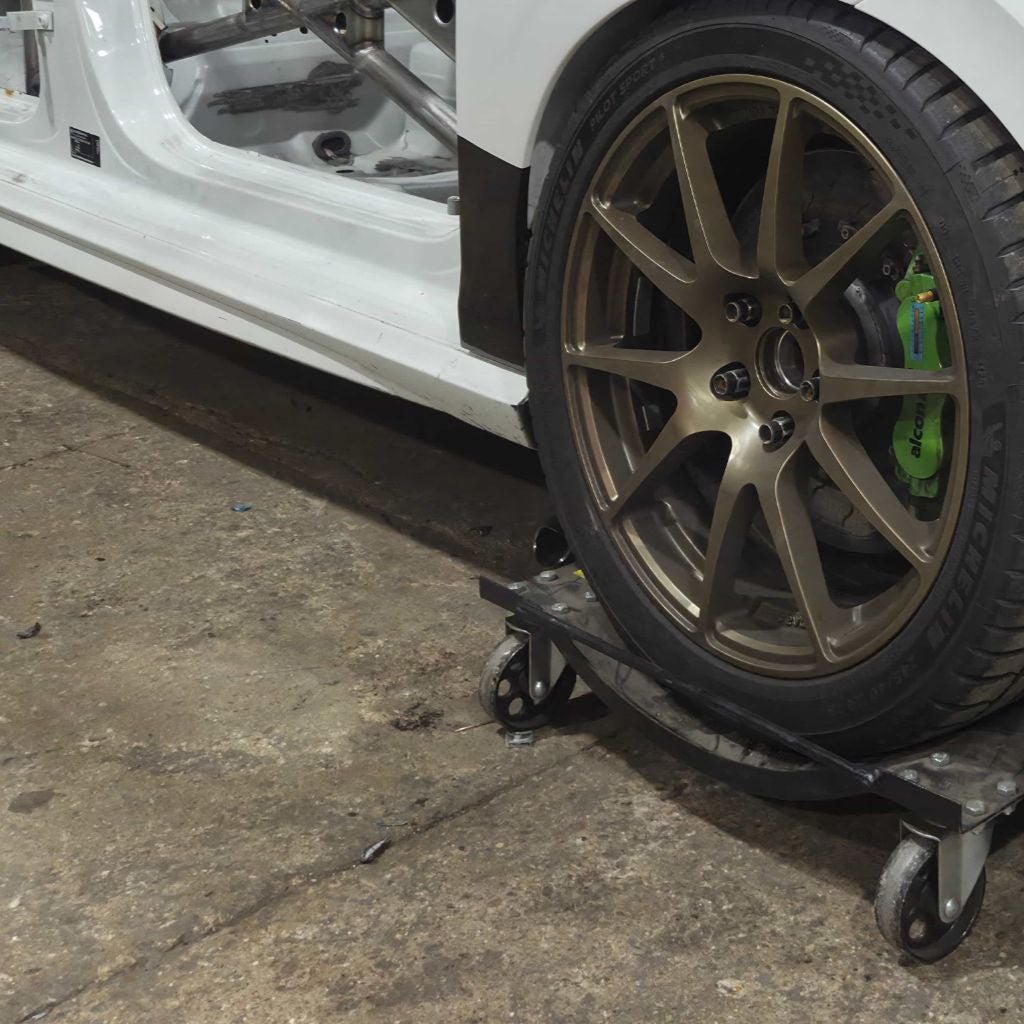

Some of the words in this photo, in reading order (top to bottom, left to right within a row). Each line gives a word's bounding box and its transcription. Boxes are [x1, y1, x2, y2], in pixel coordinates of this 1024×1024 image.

[590, 91, 616, 132] PILOT
[619, 57, 656, 95] SPORT
[909, 402, 926, 459] alcon
[926, 465, 999, 651] MICHELIN
